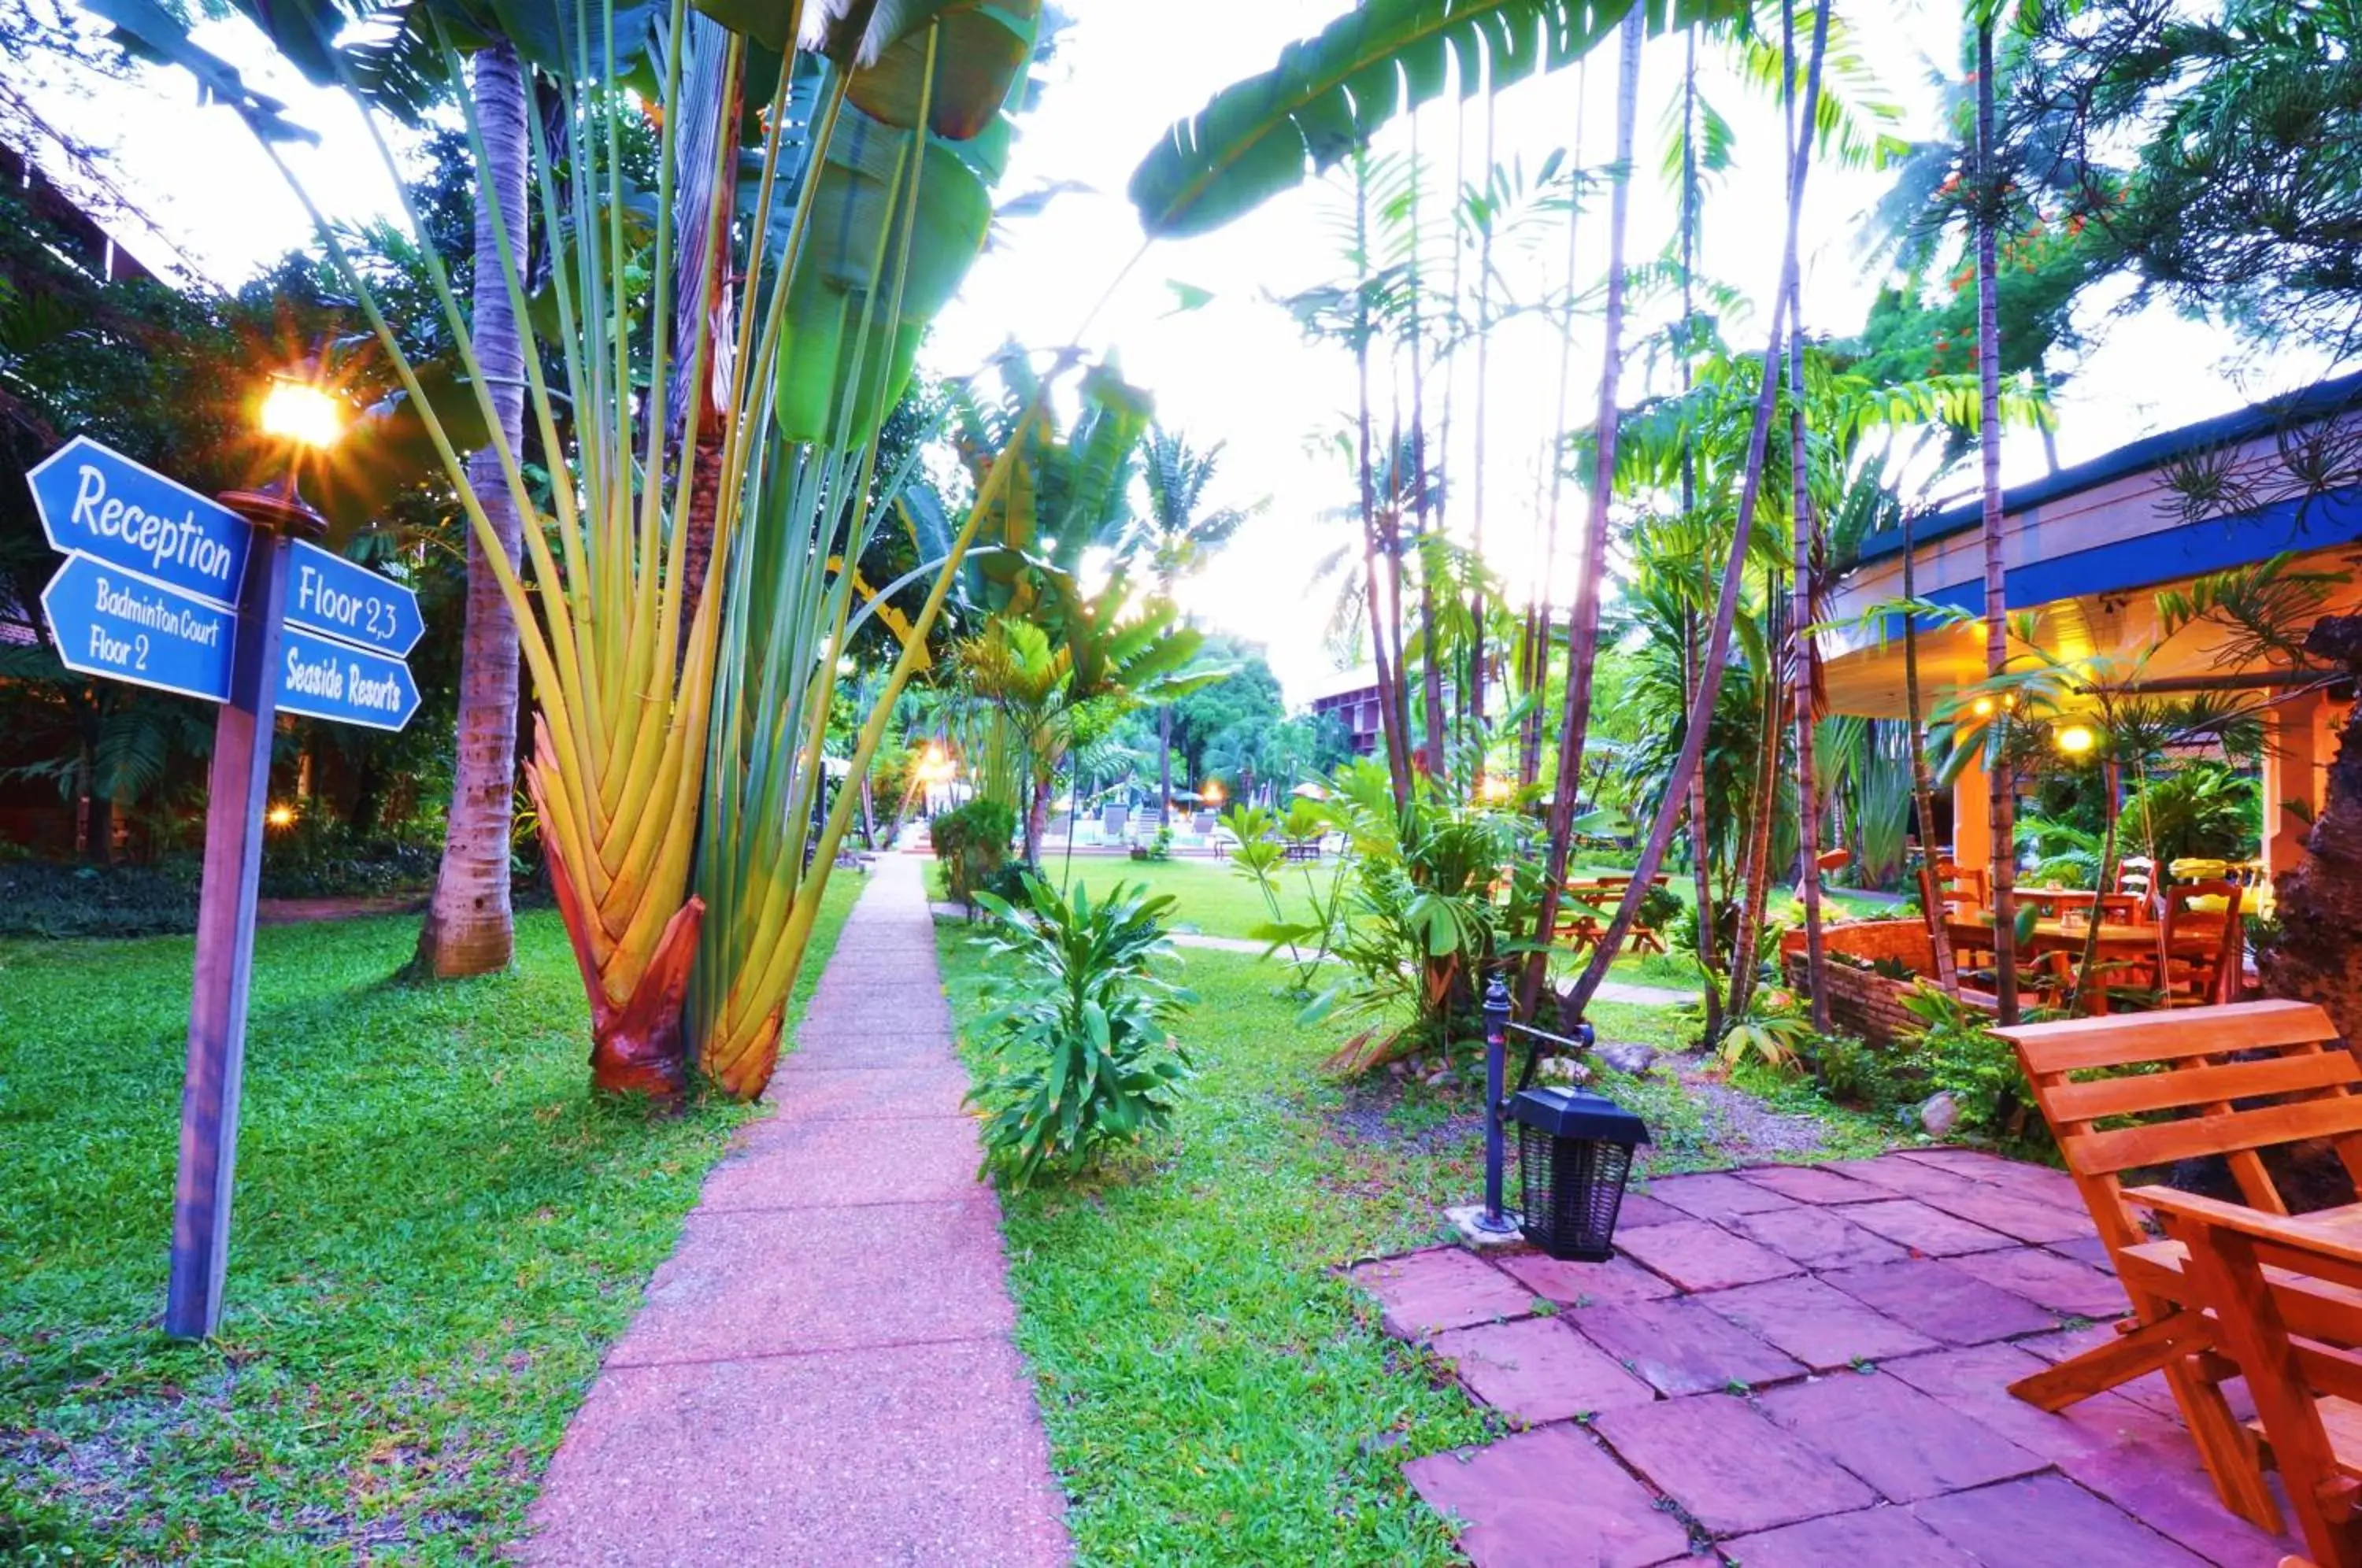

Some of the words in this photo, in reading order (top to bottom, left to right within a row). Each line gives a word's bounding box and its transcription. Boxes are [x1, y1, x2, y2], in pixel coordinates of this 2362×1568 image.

[71, 464, 231, 580] Reception
[95, 577, 179, 635] Badminton
[180, 608, 220, 648] Court
[299, 565, 362, 627] Floor
[89, 623, 131, 665] Floor
[135, 634, 150, 671] 2
[286, 646, 343, 700] Seaside
[348, 663, 401, 712] Resorts
